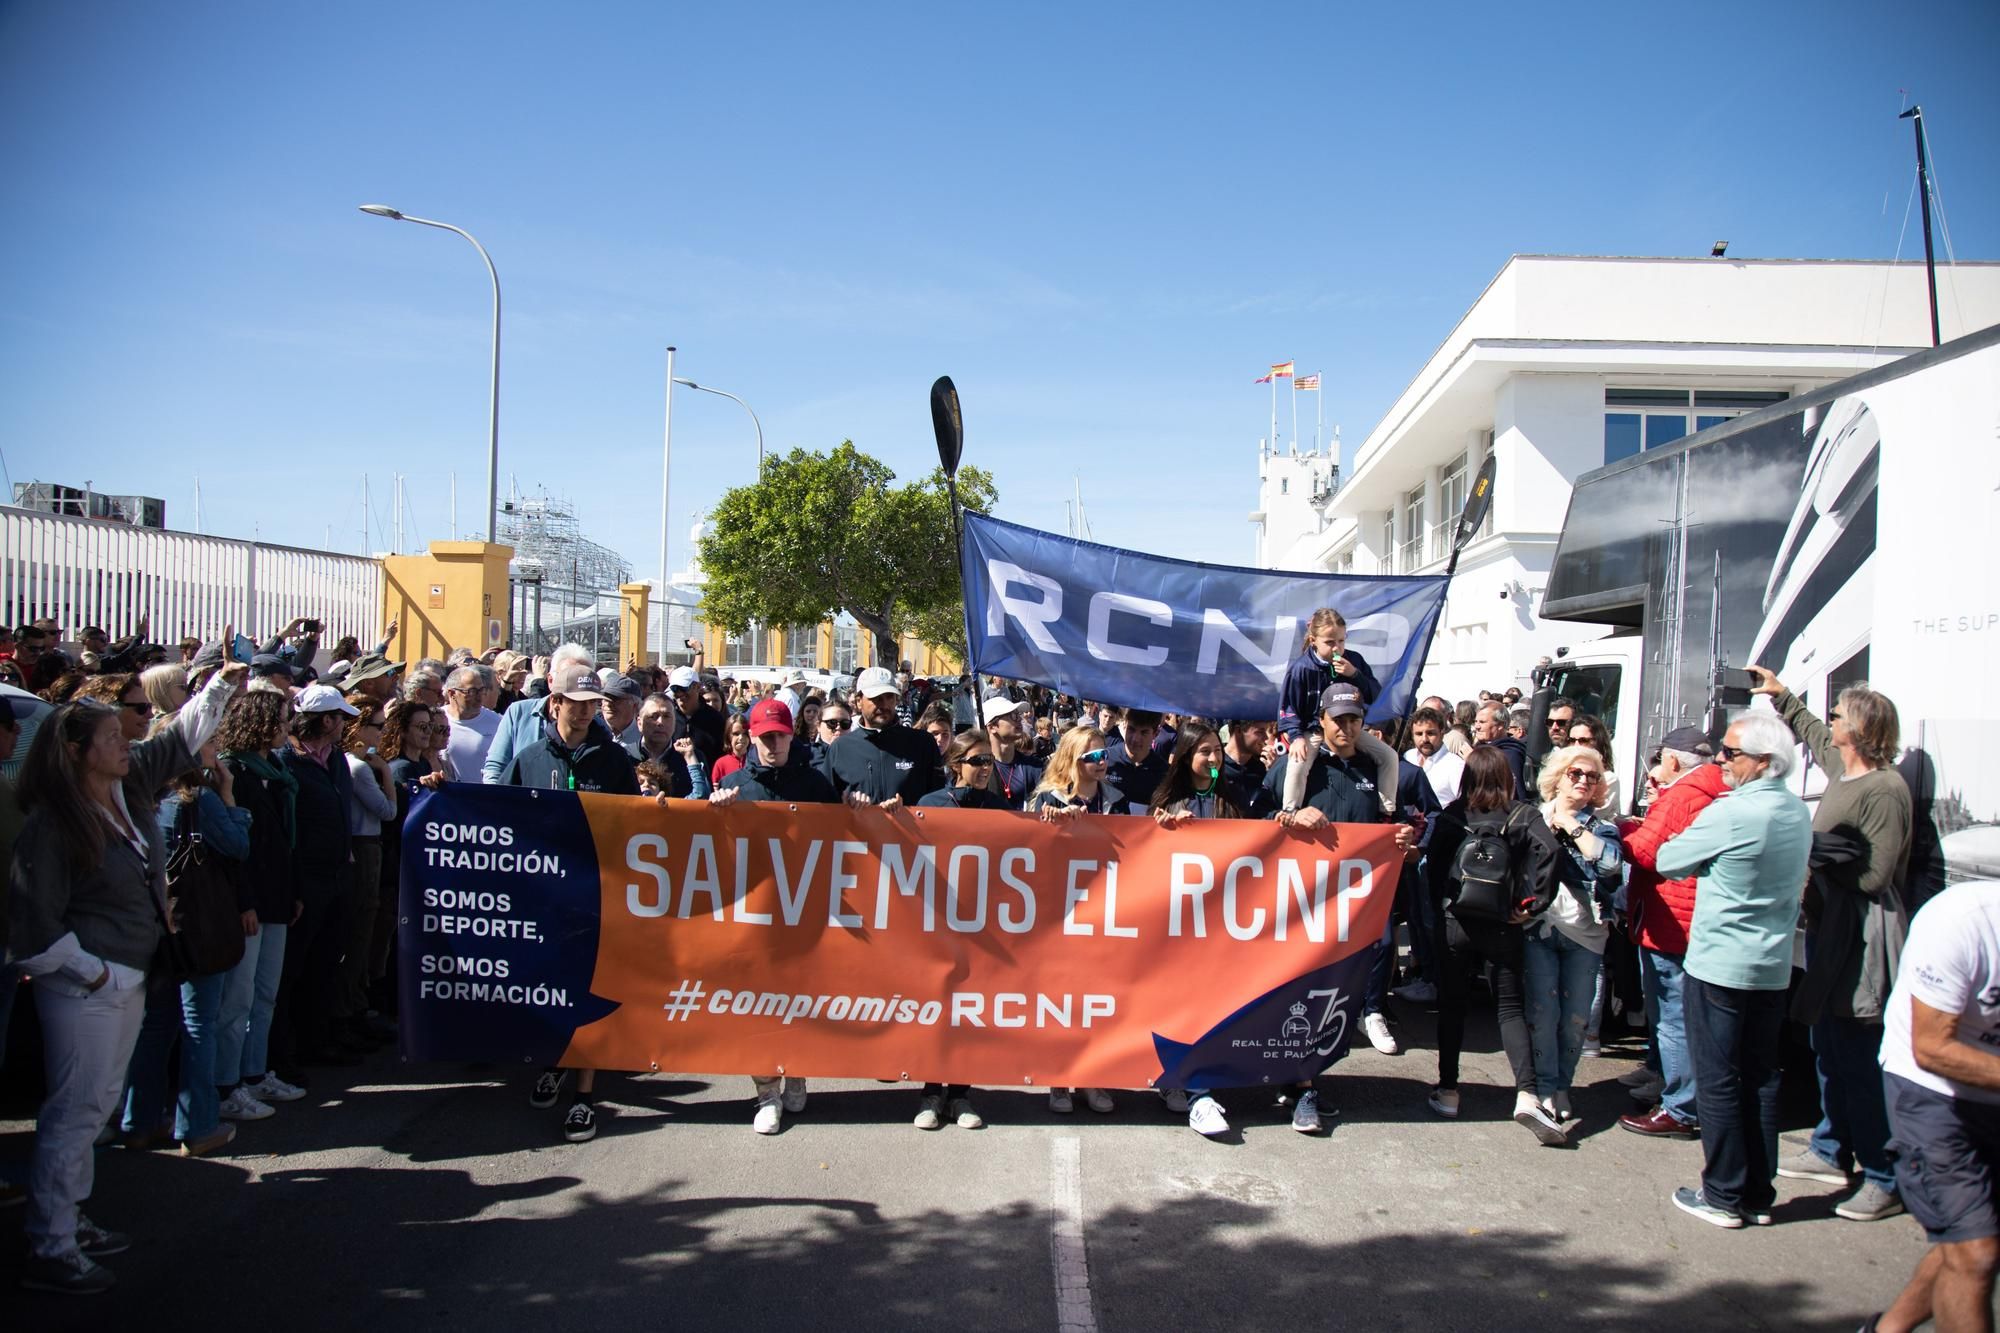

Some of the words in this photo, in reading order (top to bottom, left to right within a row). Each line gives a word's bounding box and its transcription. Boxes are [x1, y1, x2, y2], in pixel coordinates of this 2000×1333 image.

[987, 558, 1410, 684] RCNP
[1912, 617, 1949, 633] THE
[425, 821, 514, 846] SOMOS
[424, 845, 567, 878] TRADICIÓN,
[424, 888, 511, 913] SOMOS
[626, 833, 1037, 934] SALVEMOS
[1063, 859, 1139, 938] EL
[1168, 852, 1373, 943] RCNP
[422, 914, 544, 944] DEPORTE,
[421, 954, 509, 978] SOMOS
[420, 979, 574, 1008] FORMACIÓN.
[1231, 1039, 1263, 1048] REAL
[1267, 1038, 1301, 1047] CLUB
[1263, 1051, 1279, 1059] DE
